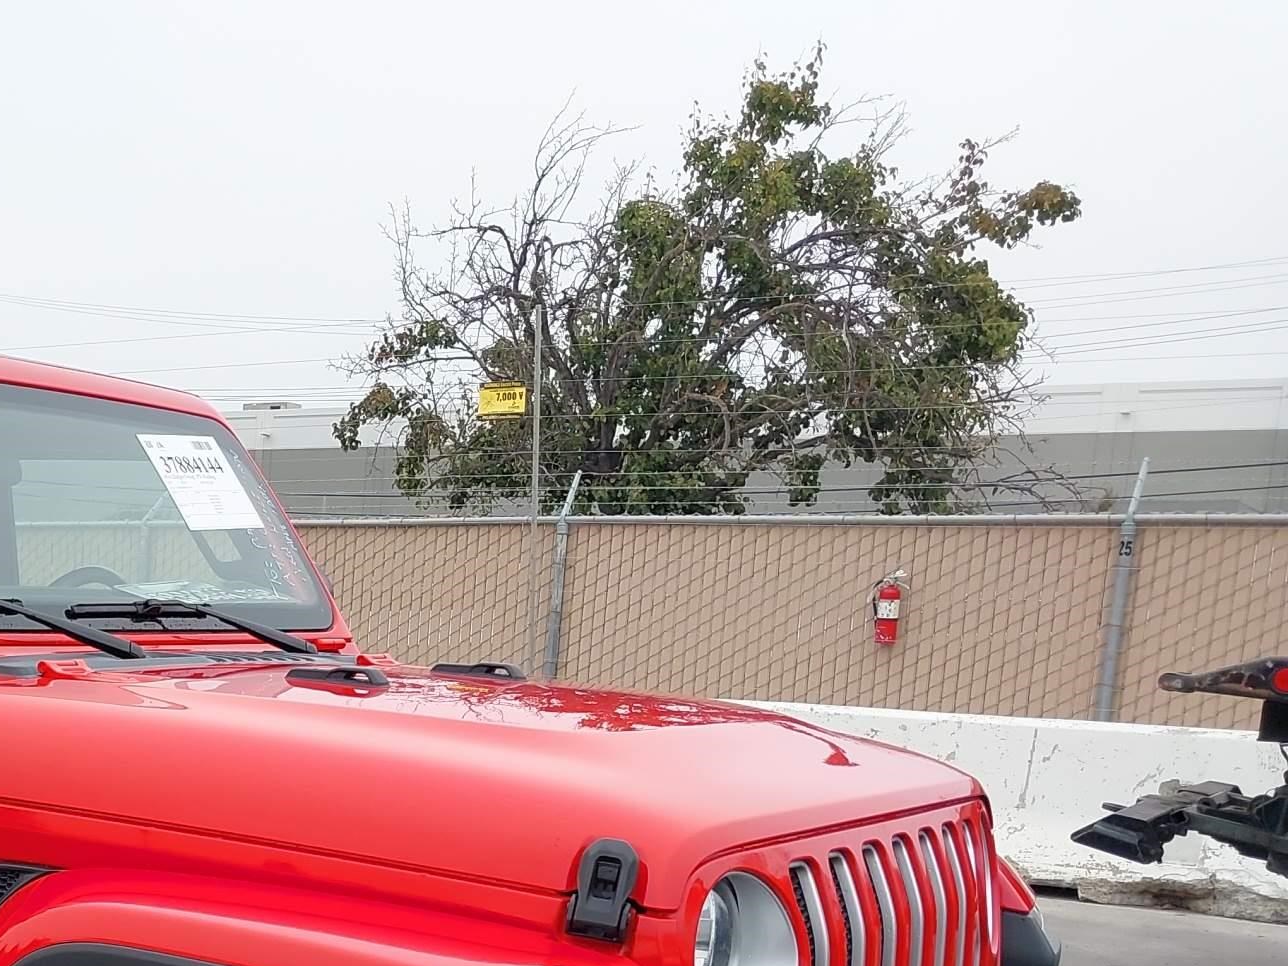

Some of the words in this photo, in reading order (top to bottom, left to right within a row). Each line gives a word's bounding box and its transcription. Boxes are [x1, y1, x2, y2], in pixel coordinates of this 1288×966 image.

[496, 391, 517, 402] 7,000
[159, 455, 224, 474] 37884144
[1119, 541, 1132, 556] 25
